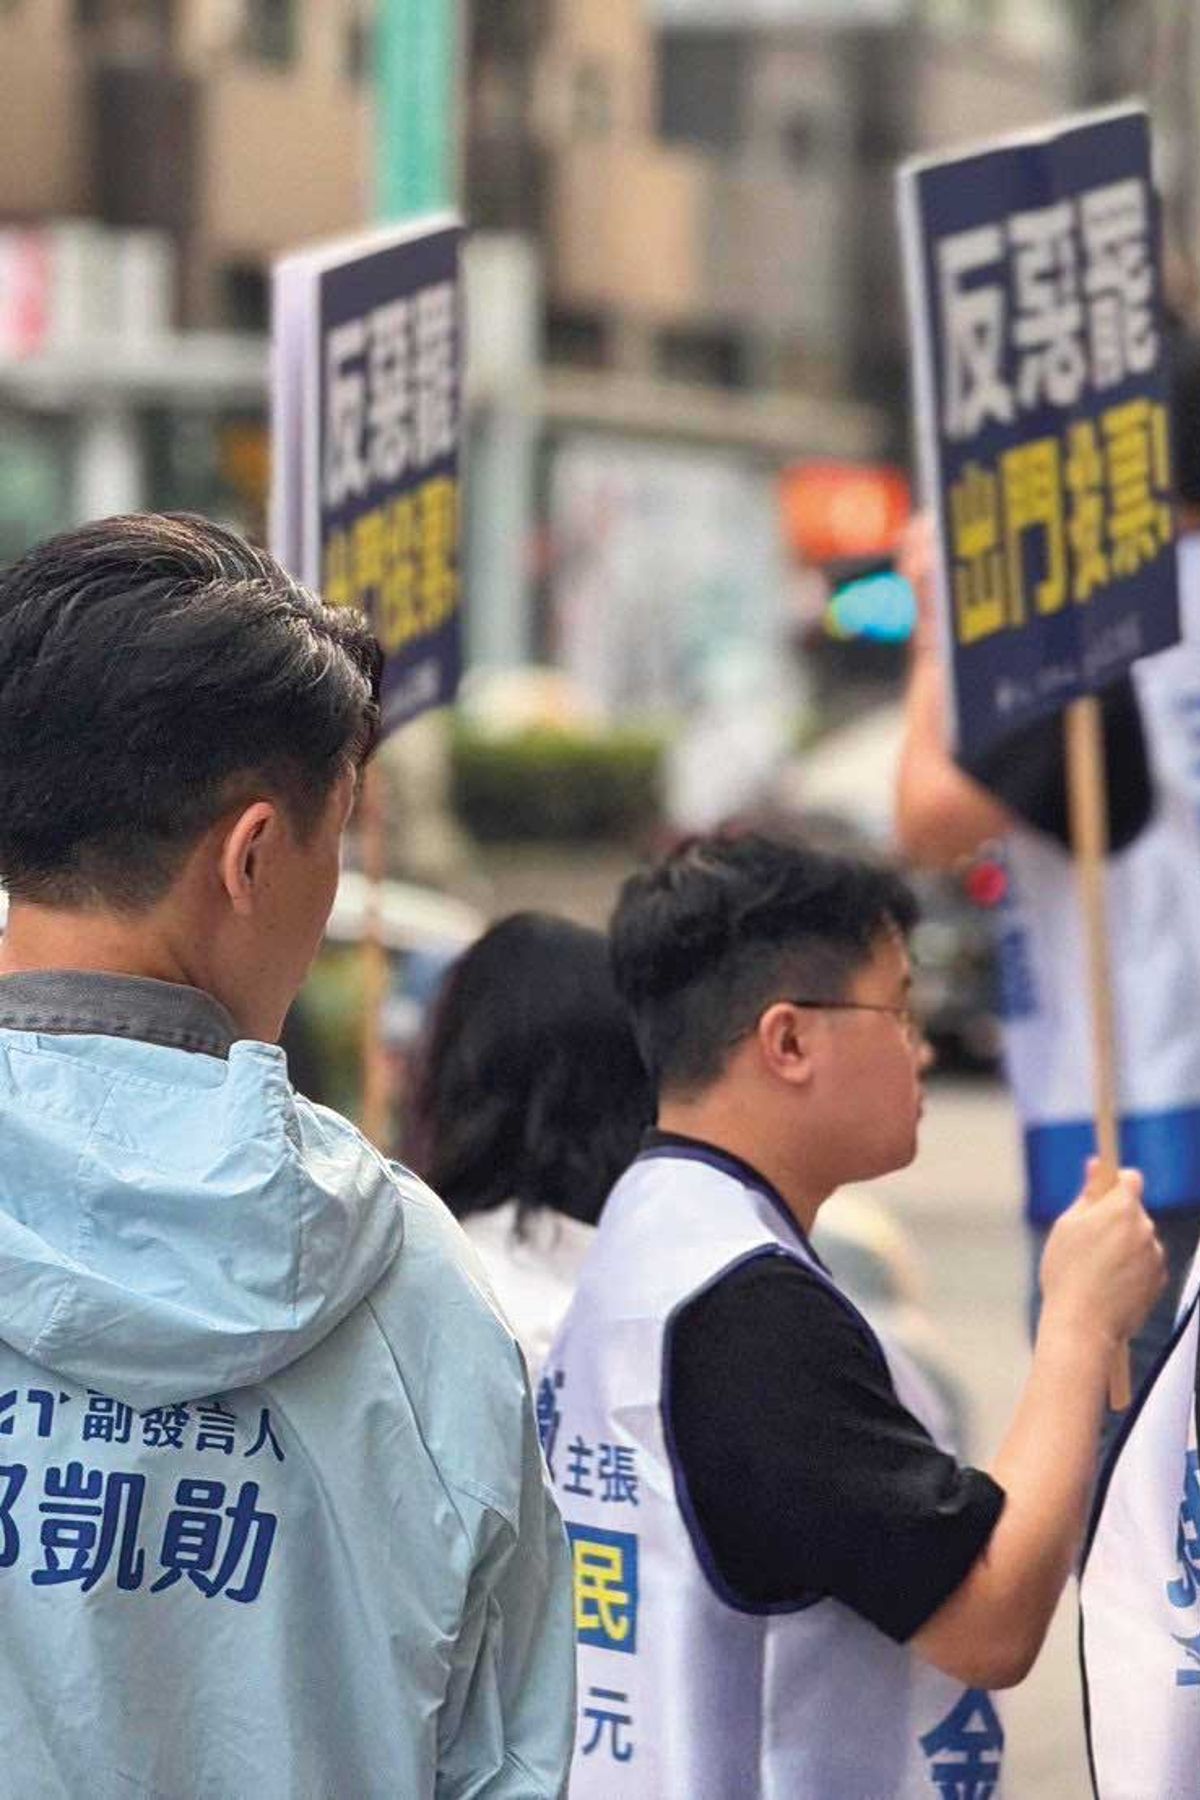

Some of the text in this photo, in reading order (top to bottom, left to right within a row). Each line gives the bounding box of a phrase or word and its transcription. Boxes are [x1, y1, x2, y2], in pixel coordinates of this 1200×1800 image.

[82, 1389, 285, 1462] 副發言人
[563, 1435, 638, 1507] 主張
[574, 1539, 628, 1641] 民
[582, 1686, 633, 1762] 元
